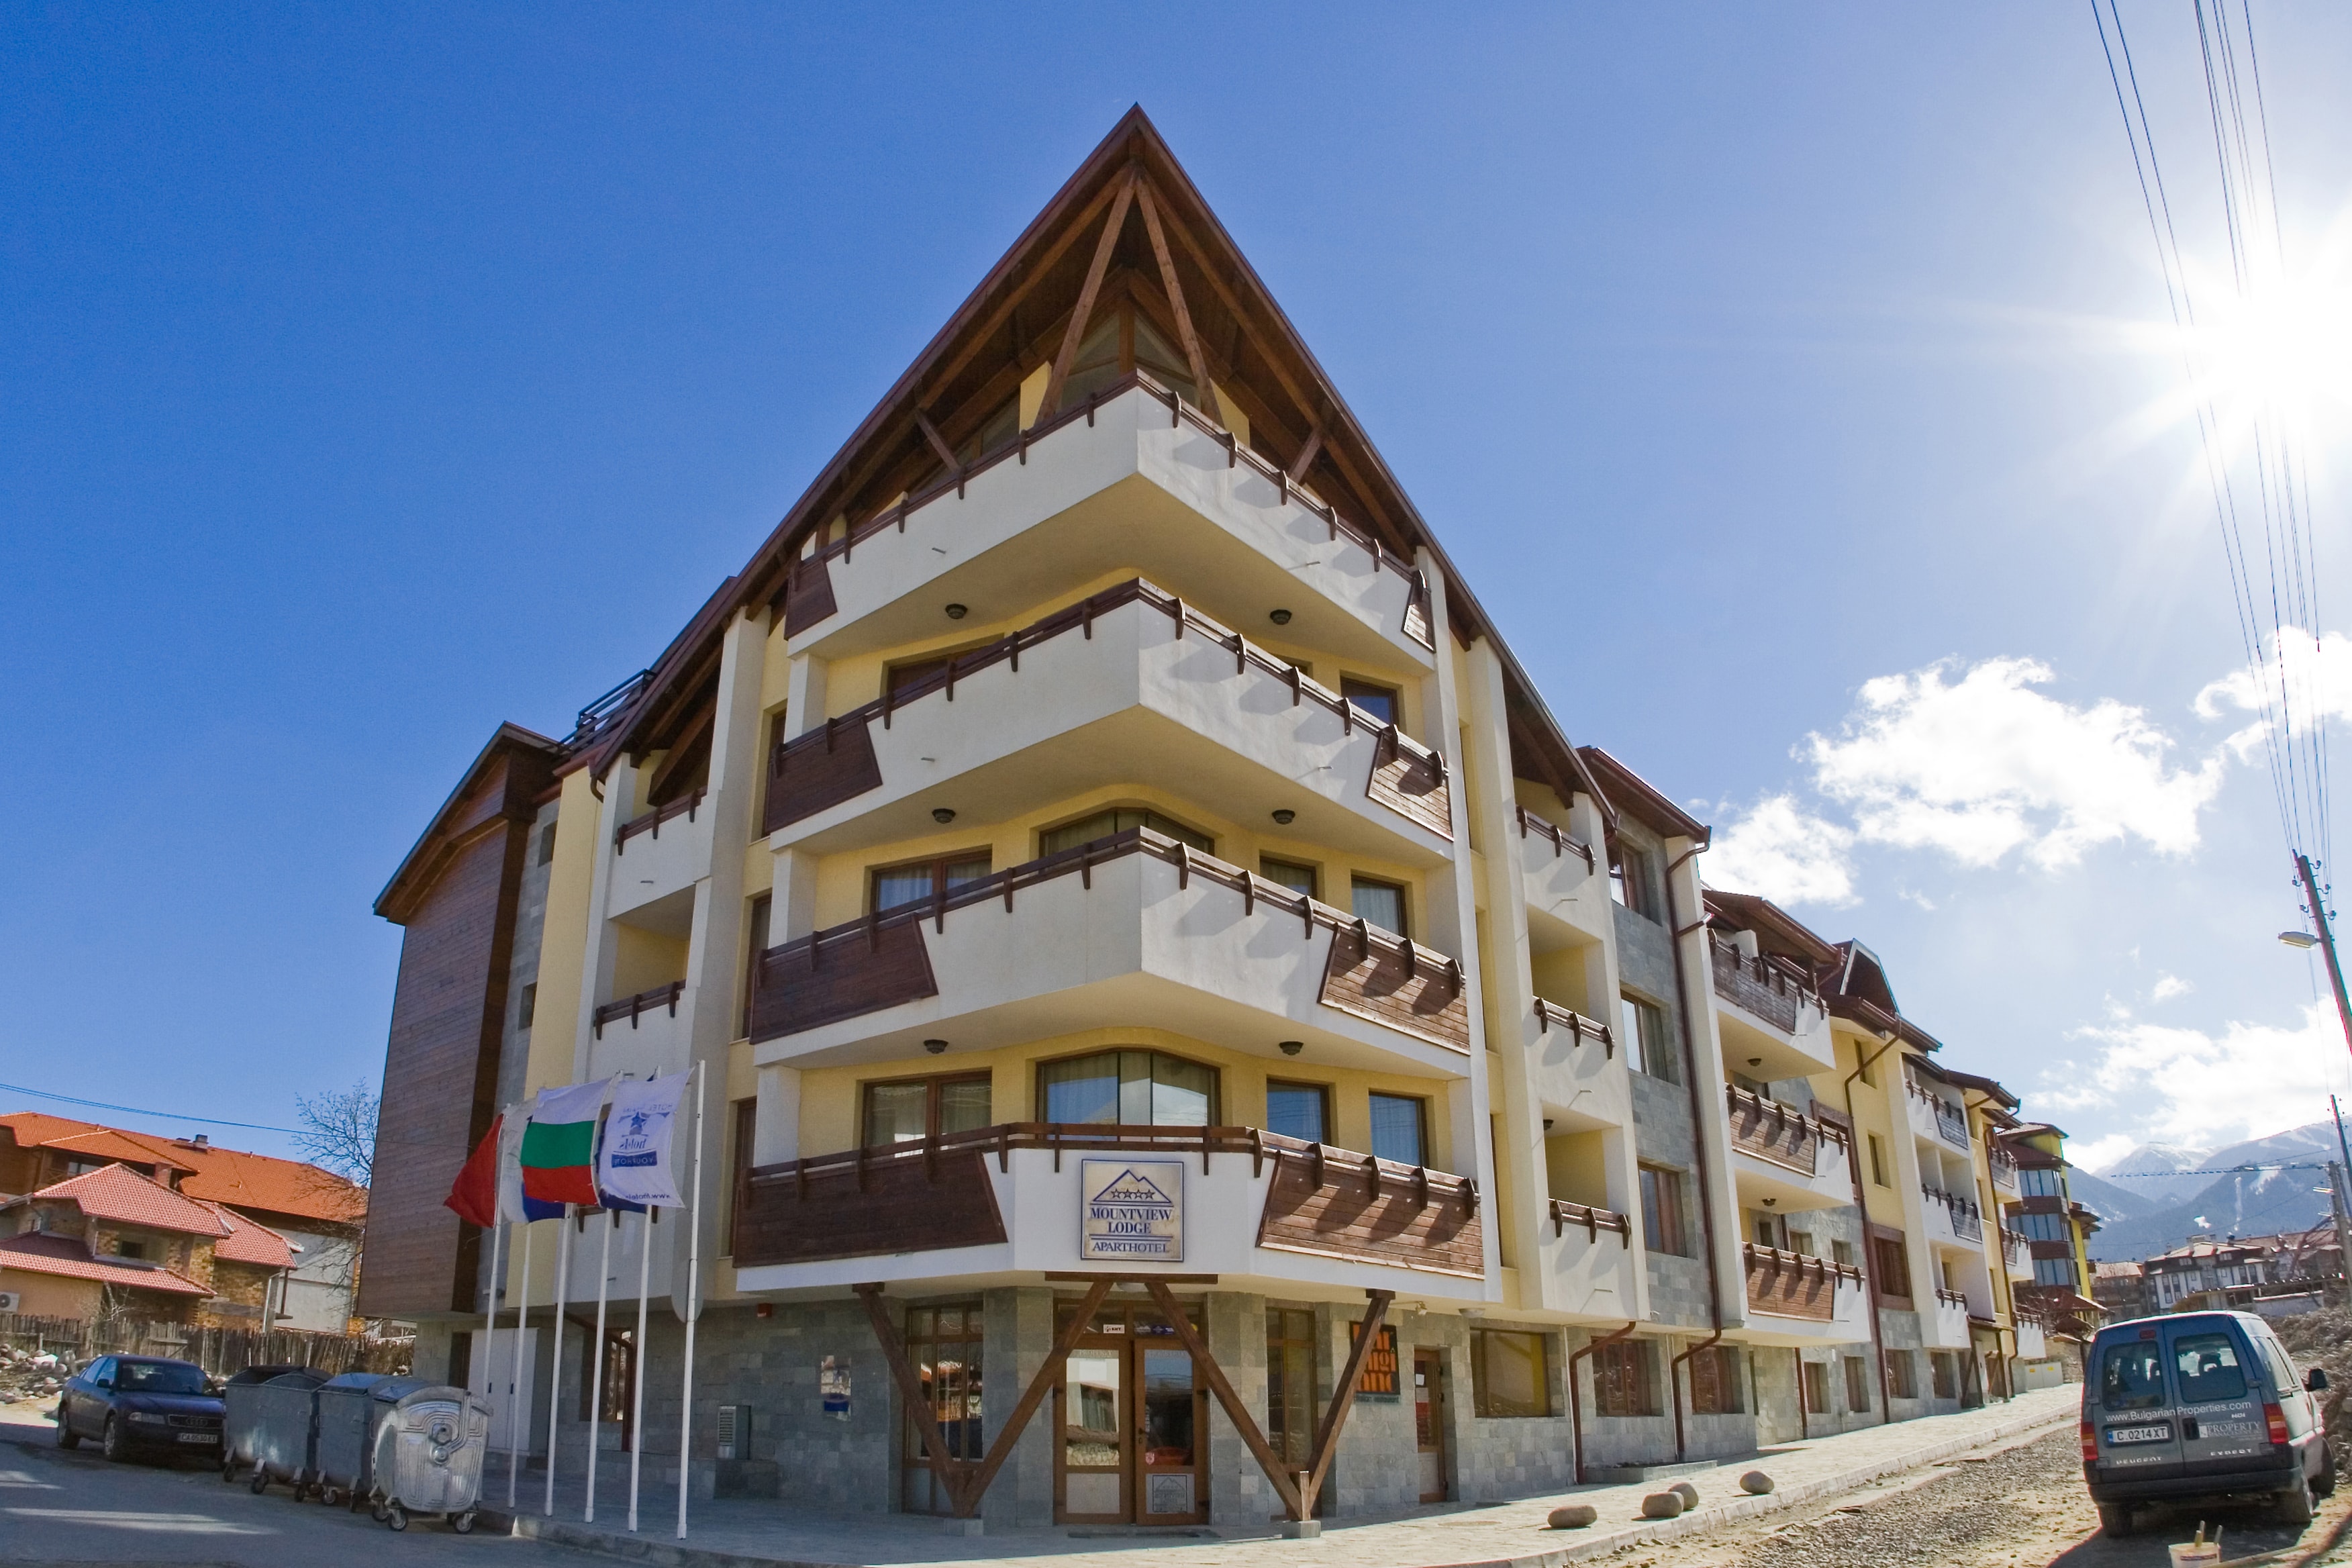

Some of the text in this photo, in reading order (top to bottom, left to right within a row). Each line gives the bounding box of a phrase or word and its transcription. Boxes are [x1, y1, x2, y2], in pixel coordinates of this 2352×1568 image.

[1090, 1208, 1173, 1221] MOUNTVIEW
[1108, 1222, 1151, 1234] LODGE
[1092, 1242, 1170, 1253] APARTHOTEL
[2207, 1420, 2260, 1433] PROPERTY
